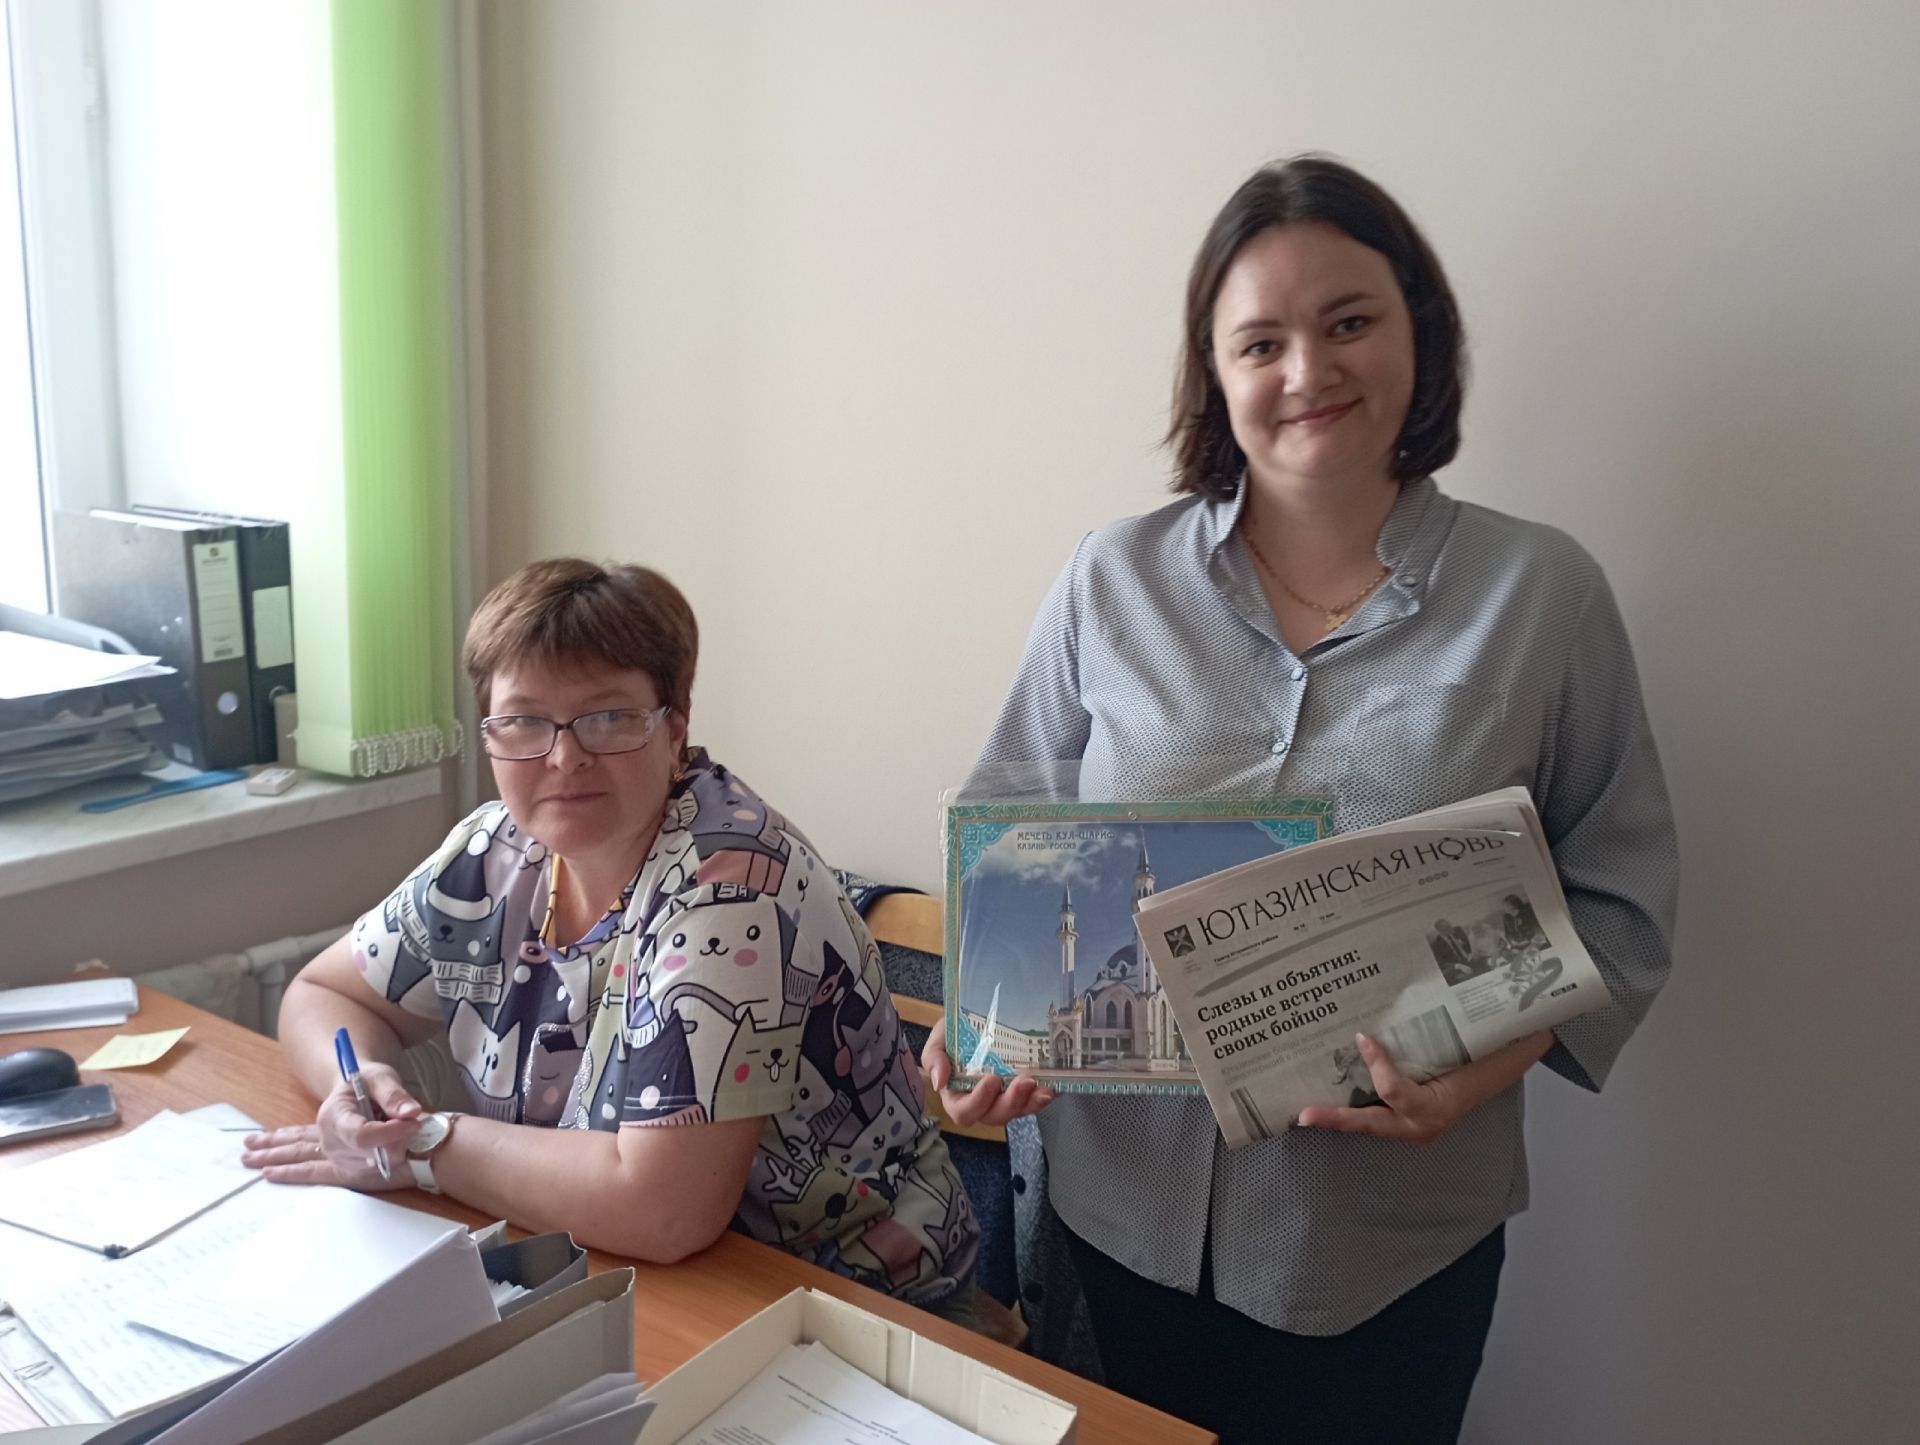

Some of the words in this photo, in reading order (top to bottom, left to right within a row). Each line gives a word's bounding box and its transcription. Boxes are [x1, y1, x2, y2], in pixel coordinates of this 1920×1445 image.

[1017, 831, 1052, 841] МЕЧЕТЬ
[1197, 848, 1411, 945] ЮТАЗИНСКАЯ
[1413, 836, 1504, 865] НОВЬ
[1197, 991, 1258, 1023] Слезы
[1259, 984, 1274, 999] и
[1276, 949, 1362, 992] объятия:
[1205, 1004, 1277, 1045] родные
[1279, 962, 1382, 1013] встретили
[1213, 1029, 1269, 1060] своих
[1270, 1000, 1339, 1037] бойцов
